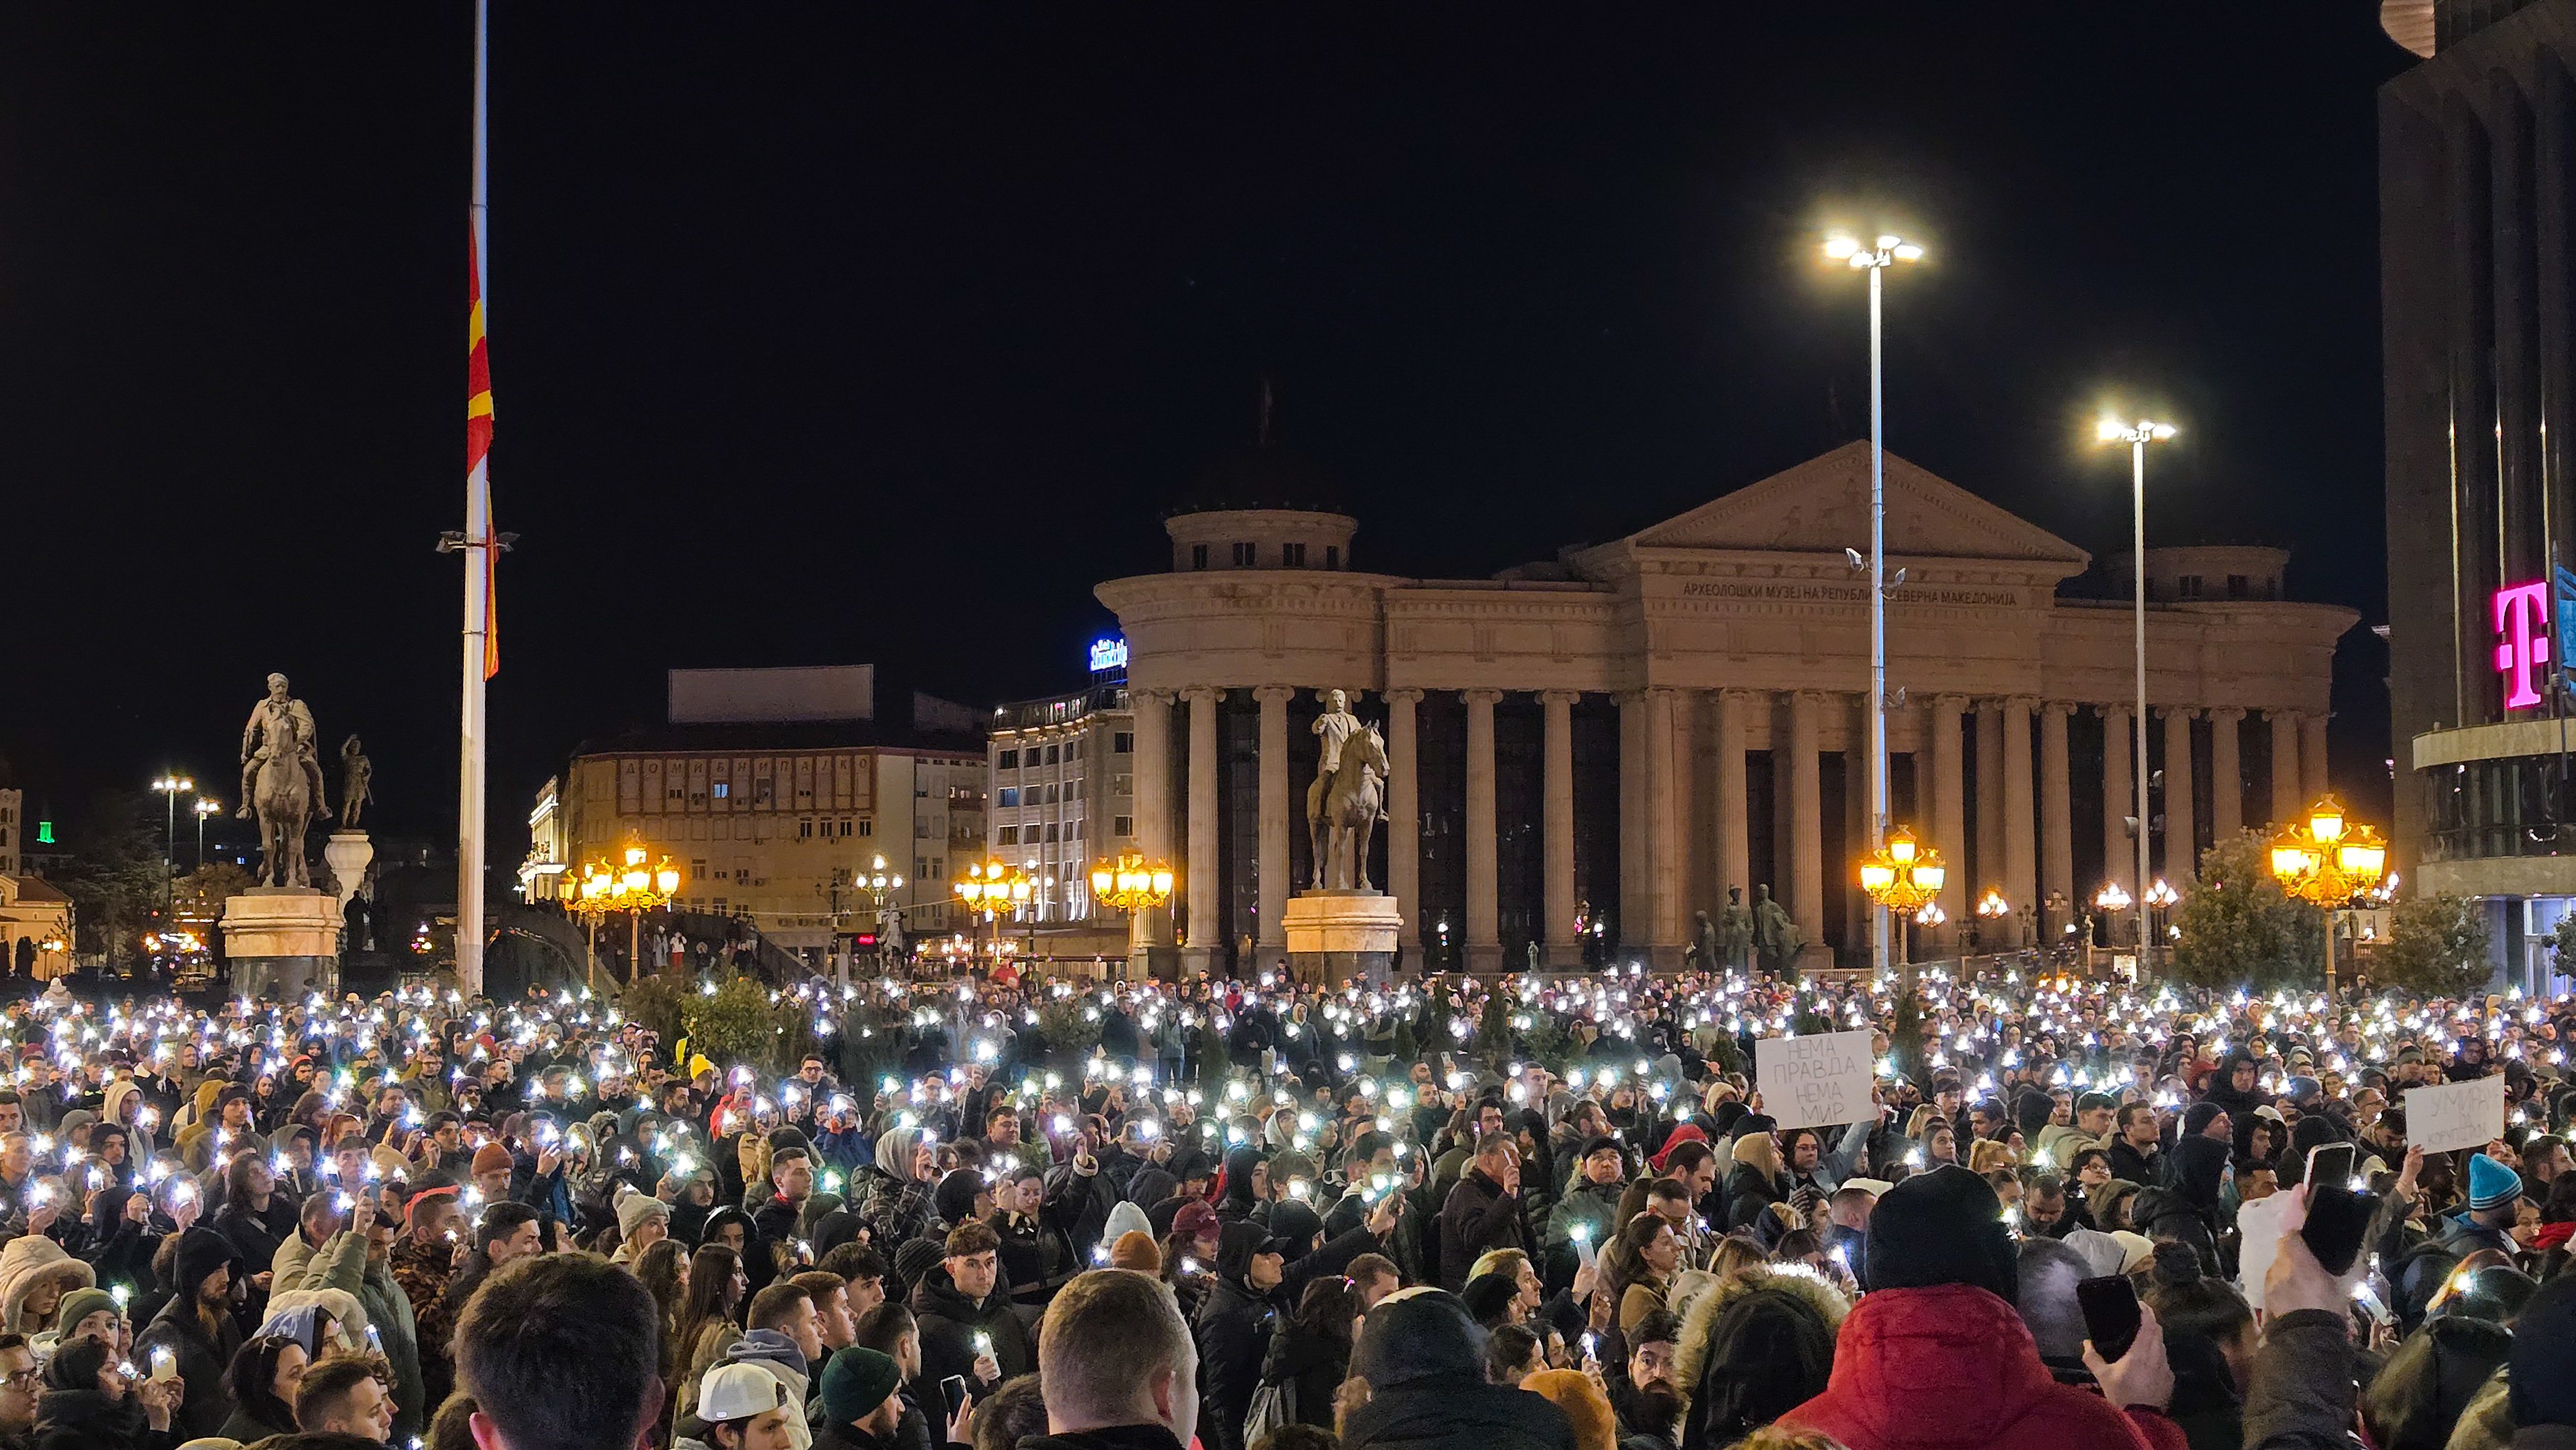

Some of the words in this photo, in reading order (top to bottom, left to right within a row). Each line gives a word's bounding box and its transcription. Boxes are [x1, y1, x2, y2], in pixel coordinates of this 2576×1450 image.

[1683, 583, 1763, 599] АРХЕОЛОШКИ
[1766, 585, 1801, 600] МУЗЕЈ
[1803, 586, 1819, 600] НА
[1940, 590, 2017, 606] МАКЕДОНИЈА
[2497, 582, 2548, 708] T
[1787, 1037, 1837, 1060] НЕМА
[1774, 1056, 1857, 1084] ПРАВДА
[1795, 1082, 1844, 1104] НЕМА
[1801, 1102, 1844, 1125] МИР
